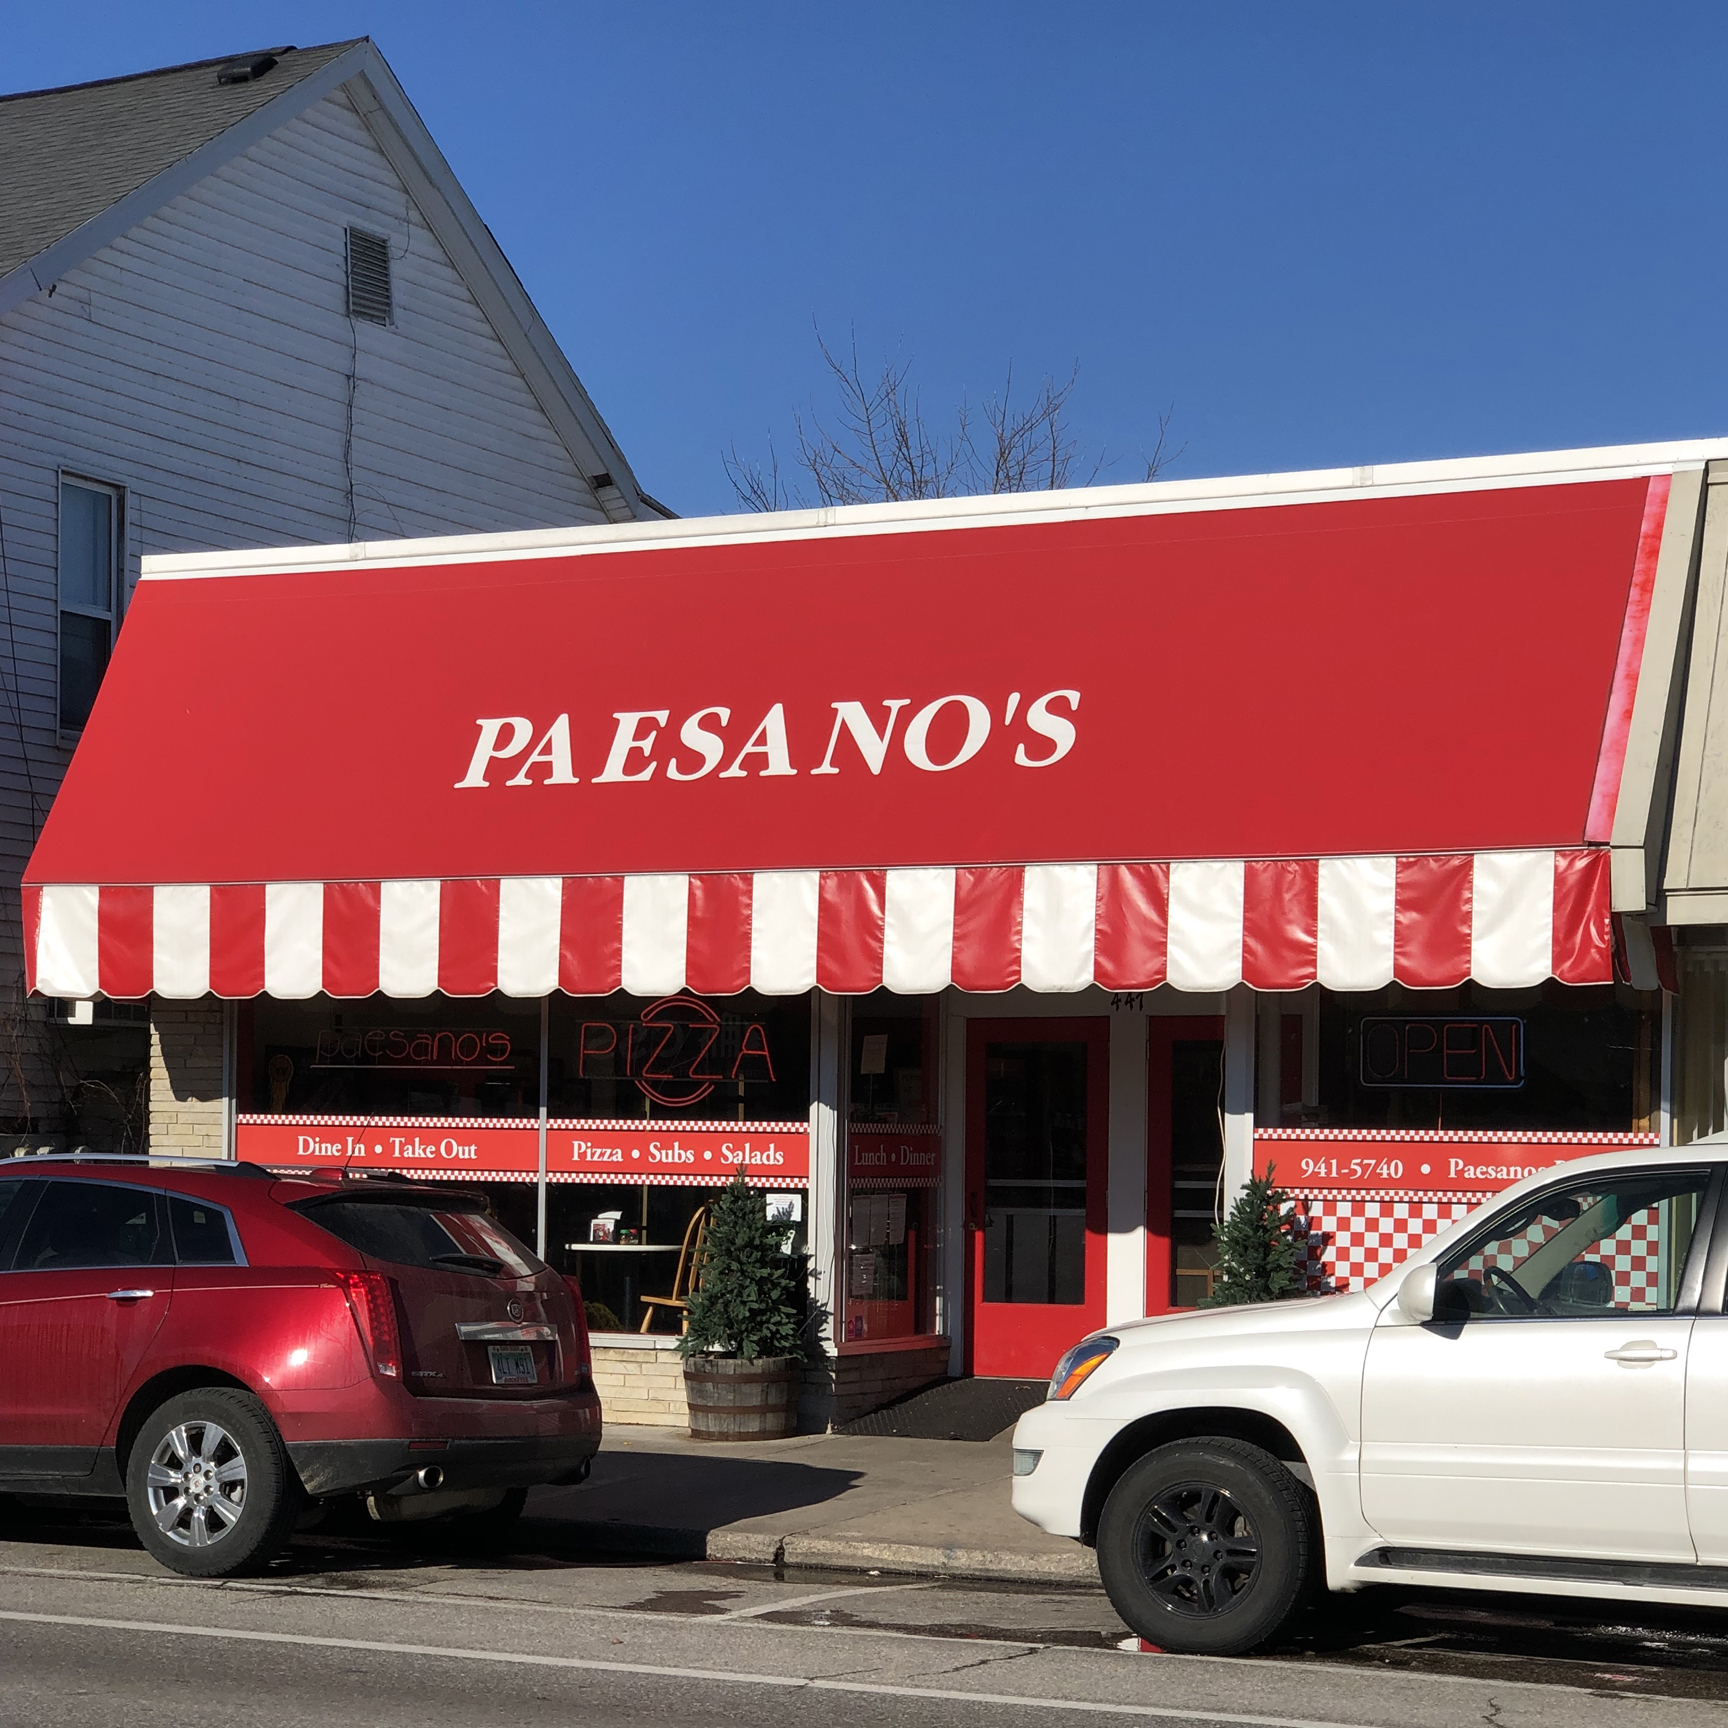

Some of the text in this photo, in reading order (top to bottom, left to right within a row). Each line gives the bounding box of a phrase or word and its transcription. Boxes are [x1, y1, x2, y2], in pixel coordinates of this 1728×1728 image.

[453, 690, 1081, 789] PAESANO'S
[1111, 992, 1144, 1012] 447
[316, 1029, 511, 1064] paesano's
[579, 1022, 777, 1082] PIZZA
[1366, 1023, 1518, 1081] OPEN
[296, 1136, 478, 1160] Dine In Take Out
[572, 1141, 784, 1165] Pizza Subs Salads
[854, 1145, 936, 1166] Lunch Dinner
[1300, 1157, 1404, 1180] 941-5740
